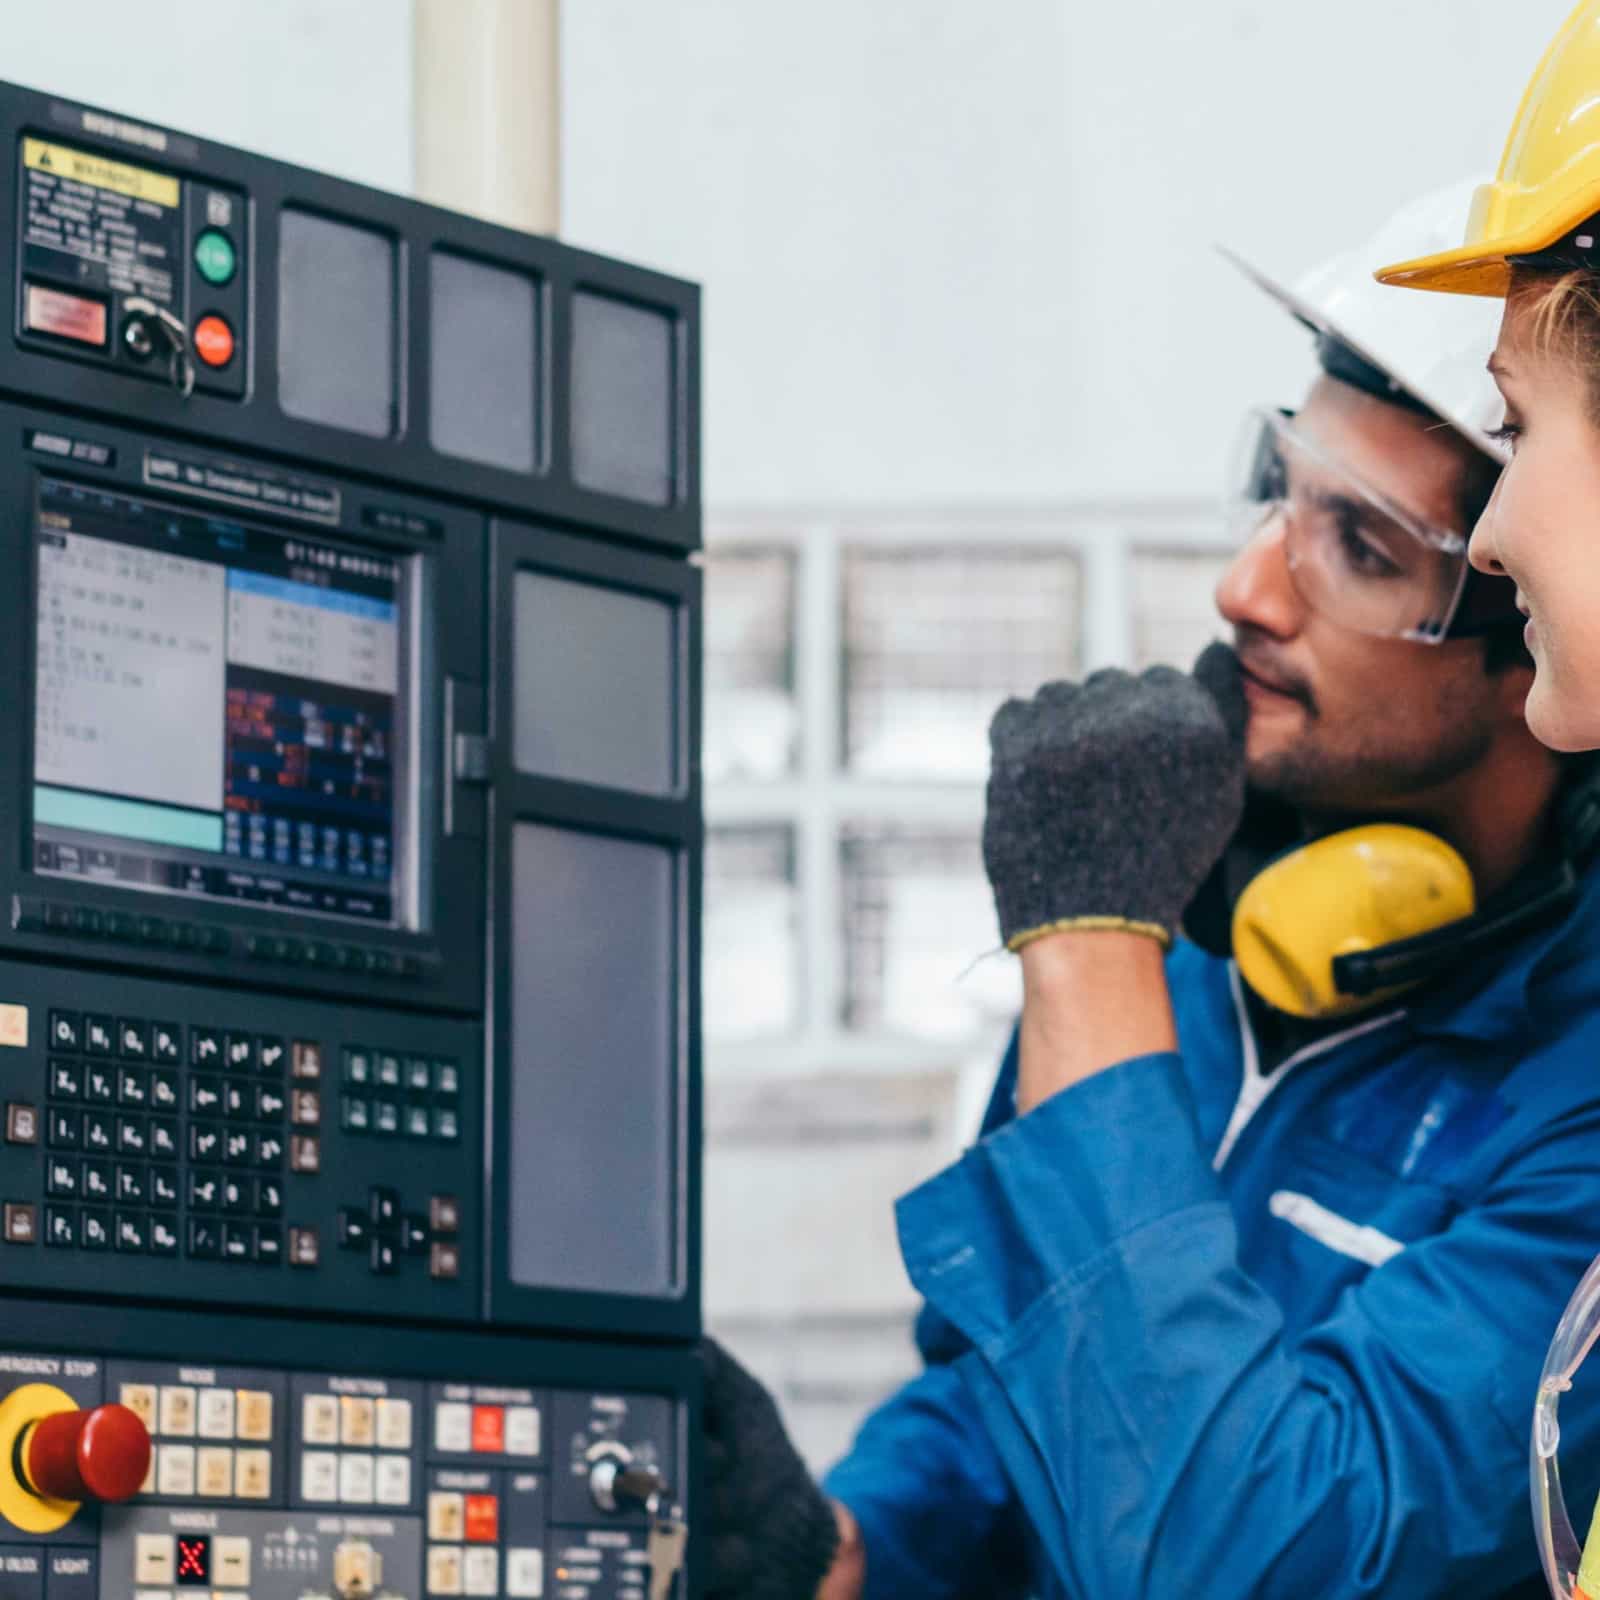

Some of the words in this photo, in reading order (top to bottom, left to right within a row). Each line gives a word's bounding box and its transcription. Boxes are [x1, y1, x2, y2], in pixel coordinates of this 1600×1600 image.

[64, 1360, 97, 1377] STOP
[53, 1558, 90, 1575] LIGHT
[178, 1539, 206, 1577] X
